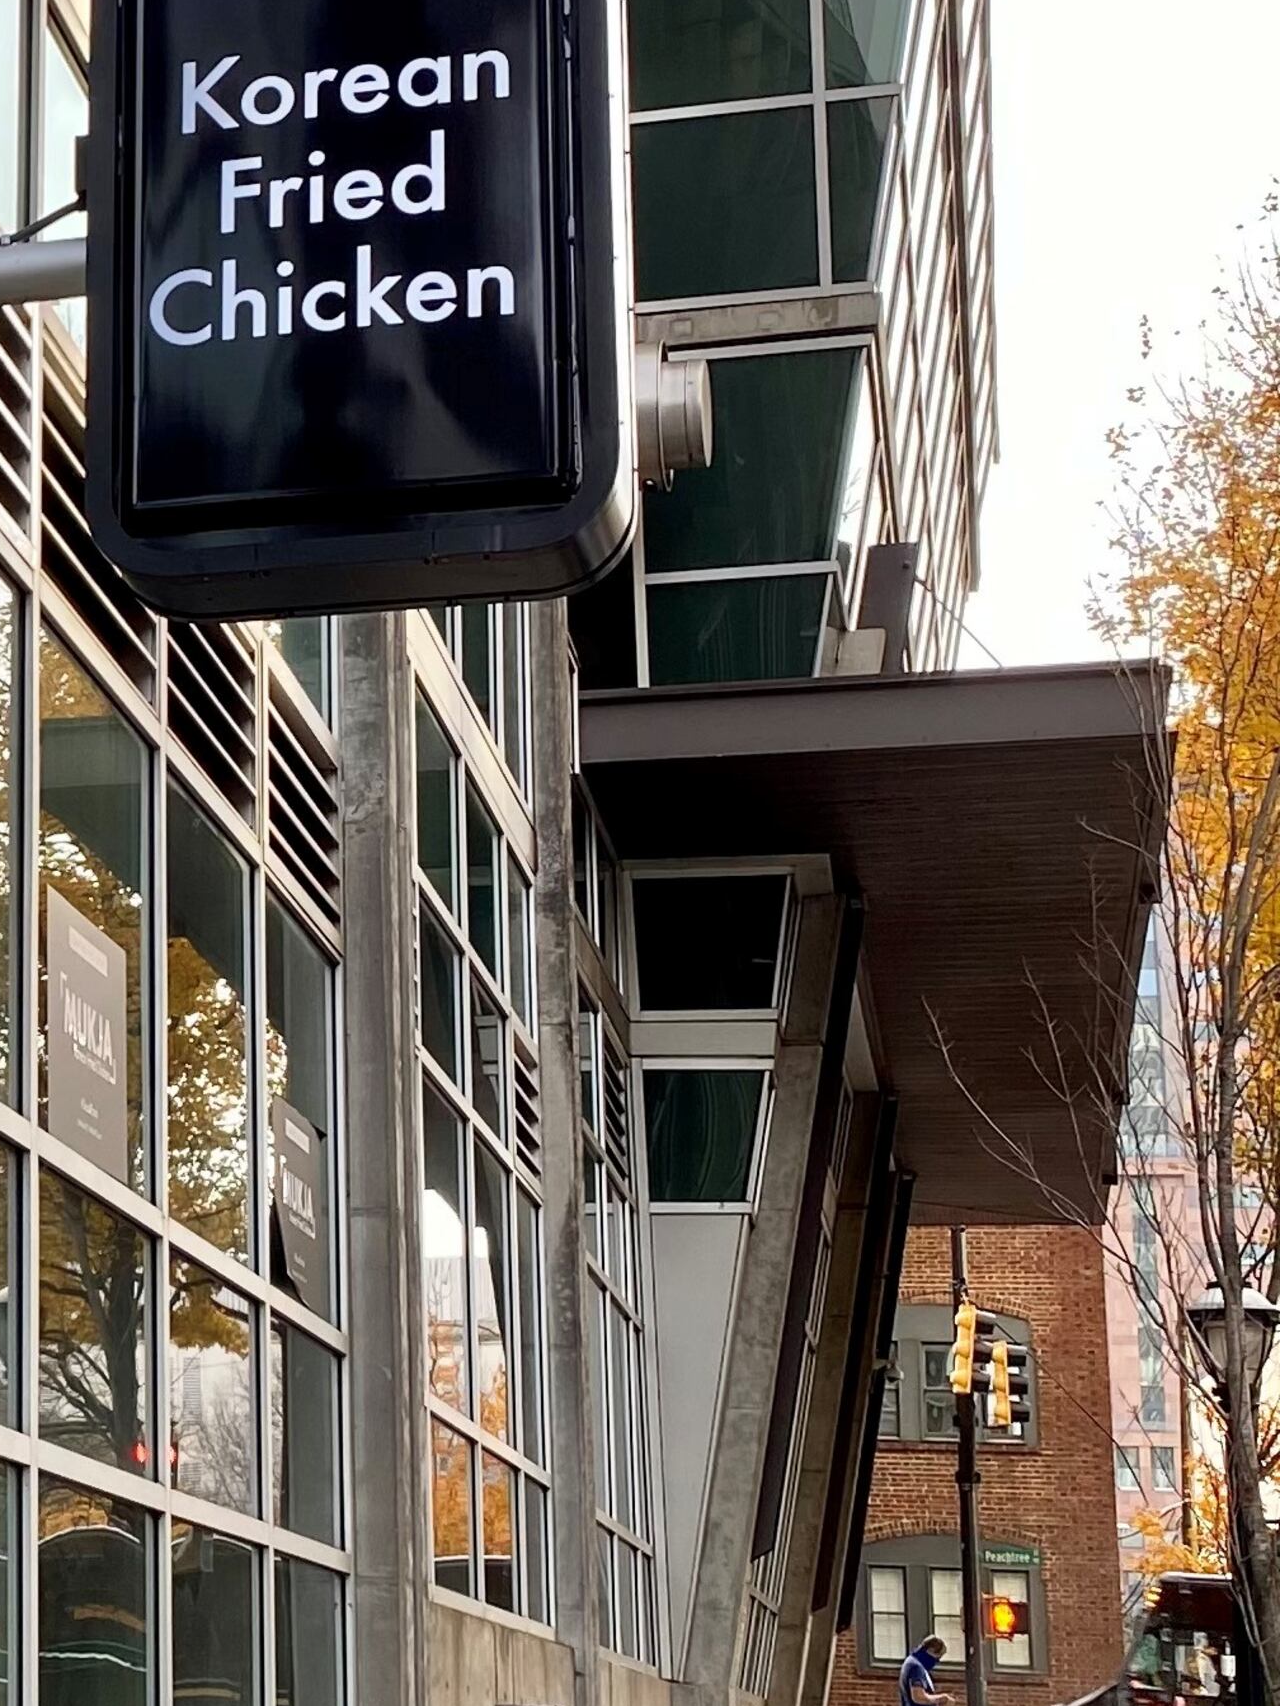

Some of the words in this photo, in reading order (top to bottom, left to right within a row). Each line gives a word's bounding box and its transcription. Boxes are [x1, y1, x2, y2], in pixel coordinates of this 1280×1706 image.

[181, 49, 510, 135] Korean
[220, 129, 446, 234] Fried
[149, 244, 516, 346] Chicken
[985, 1550, 1031, 1563] Peachtree
